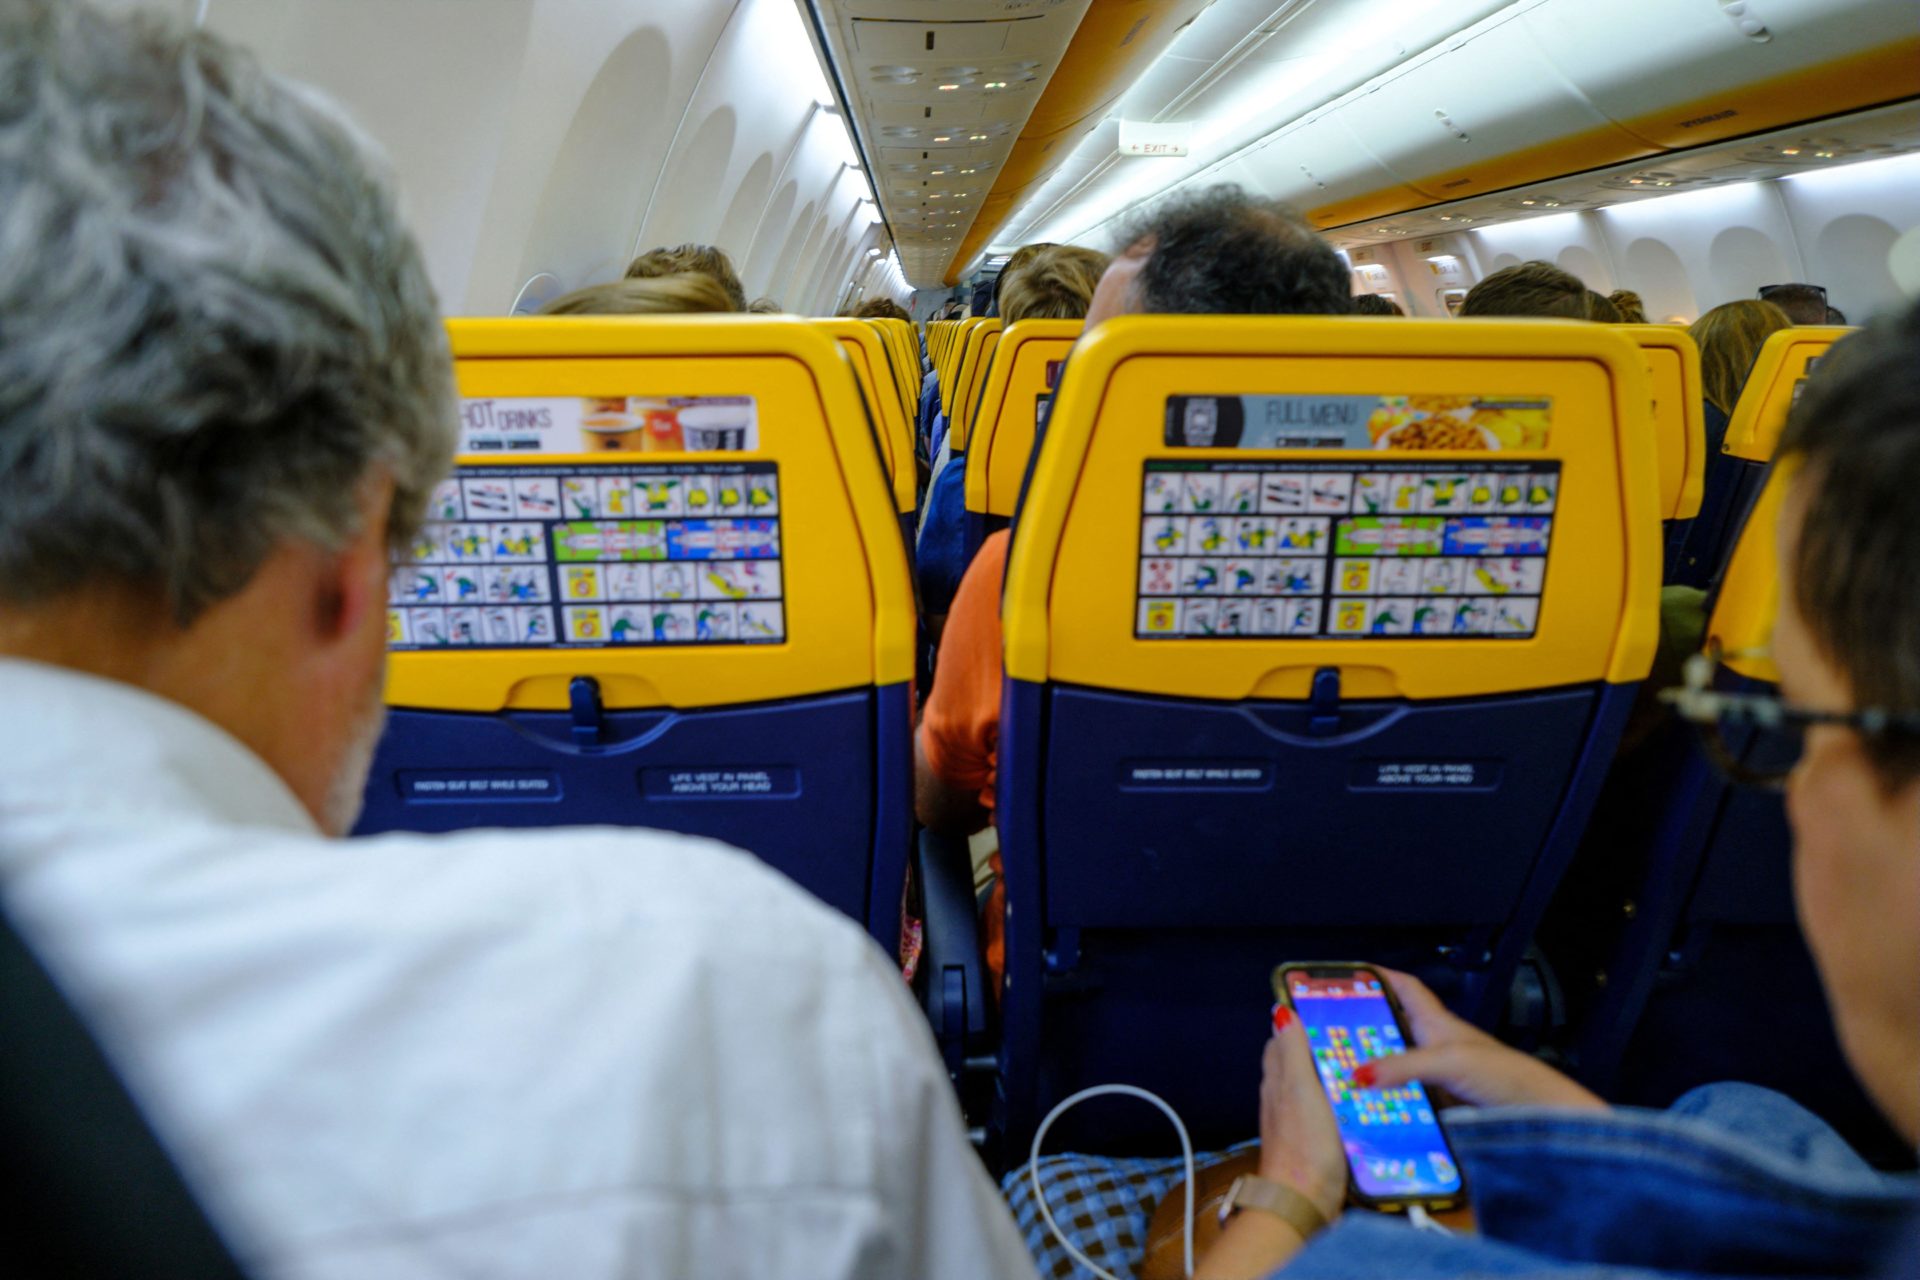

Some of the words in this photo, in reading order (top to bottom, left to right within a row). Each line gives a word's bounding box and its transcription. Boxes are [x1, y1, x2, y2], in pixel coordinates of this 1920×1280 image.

[1144, 144, 1168, 153] EXIT
[1265, 400, 1307, 424] FULL
[1309, 402, 1359, 427] MENU
[498, 407, 553, 431] DRINKS
[670, 773, 692, 782] LIFE
[694, 772, 720, 782] VEST
[723, 772, 735, 781] IN
[672, 783, 707, 792] ABOVE
[711, 783, 740, 792] YOUR
[742, 782, 772, 792] HEAD
